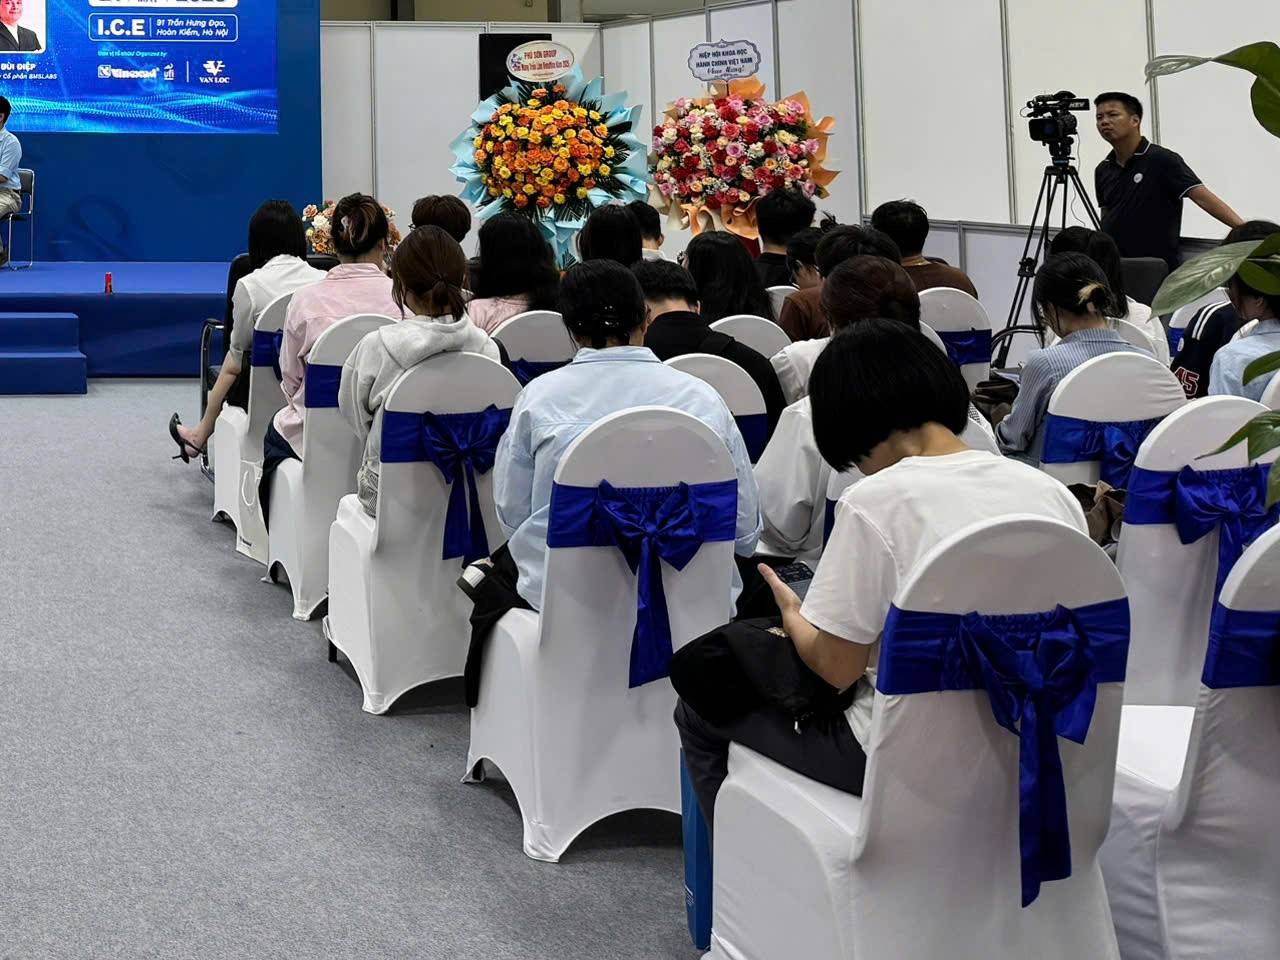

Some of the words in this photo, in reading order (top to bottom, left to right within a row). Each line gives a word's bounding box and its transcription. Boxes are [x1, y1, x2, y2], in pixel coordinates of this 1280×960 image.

[97, 19, 145, 36] I.C.E
[186, 19, 206, 28] Hưng
[208, 19, 226, 28] Đạo,
